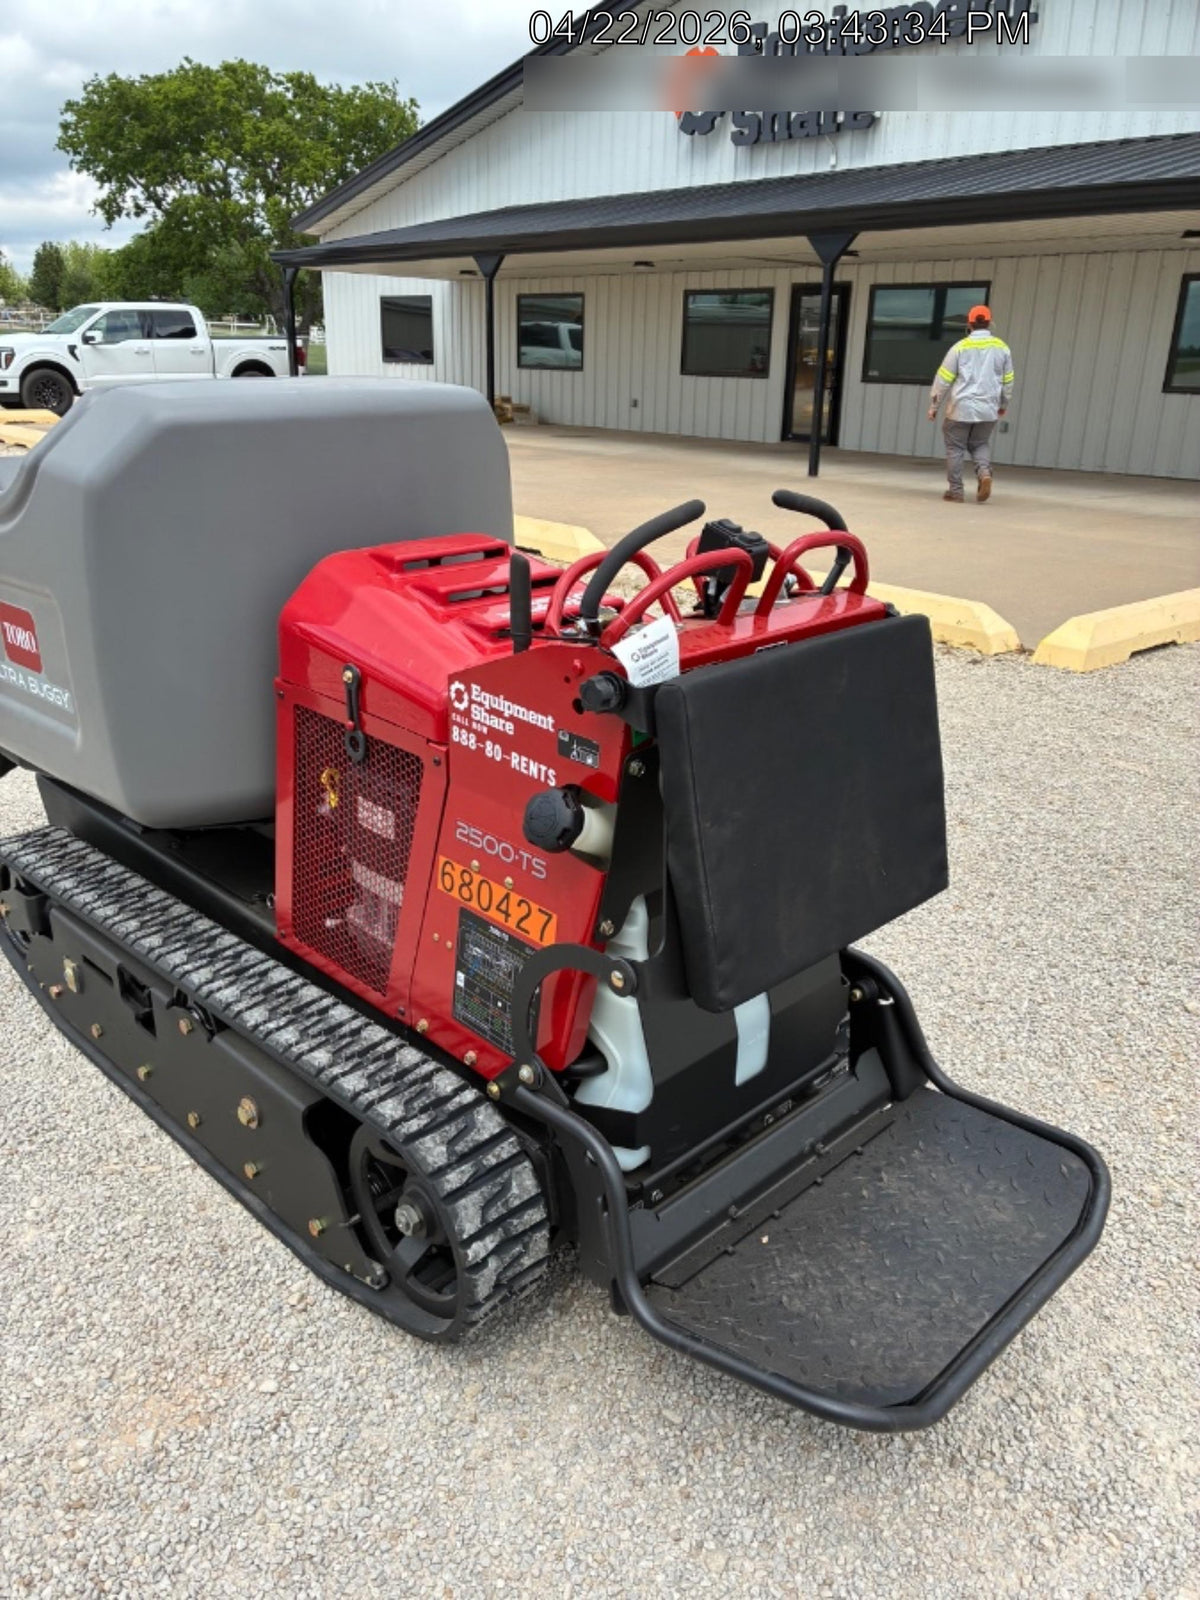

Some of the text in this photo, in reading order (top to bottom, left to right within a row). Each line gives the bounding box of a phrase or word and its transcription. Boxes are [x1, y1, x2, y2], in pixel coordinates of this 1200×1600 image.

[2, 621, 38, 654] TORO
[28, 676, 71, 709] BUGGY
[470, 683, 555, 733] Equipment
[470, 703, 515, 736] Share
[451, 724, 557, 787] 888-80-RENTS
[440, 859, 554, 942] 680427
